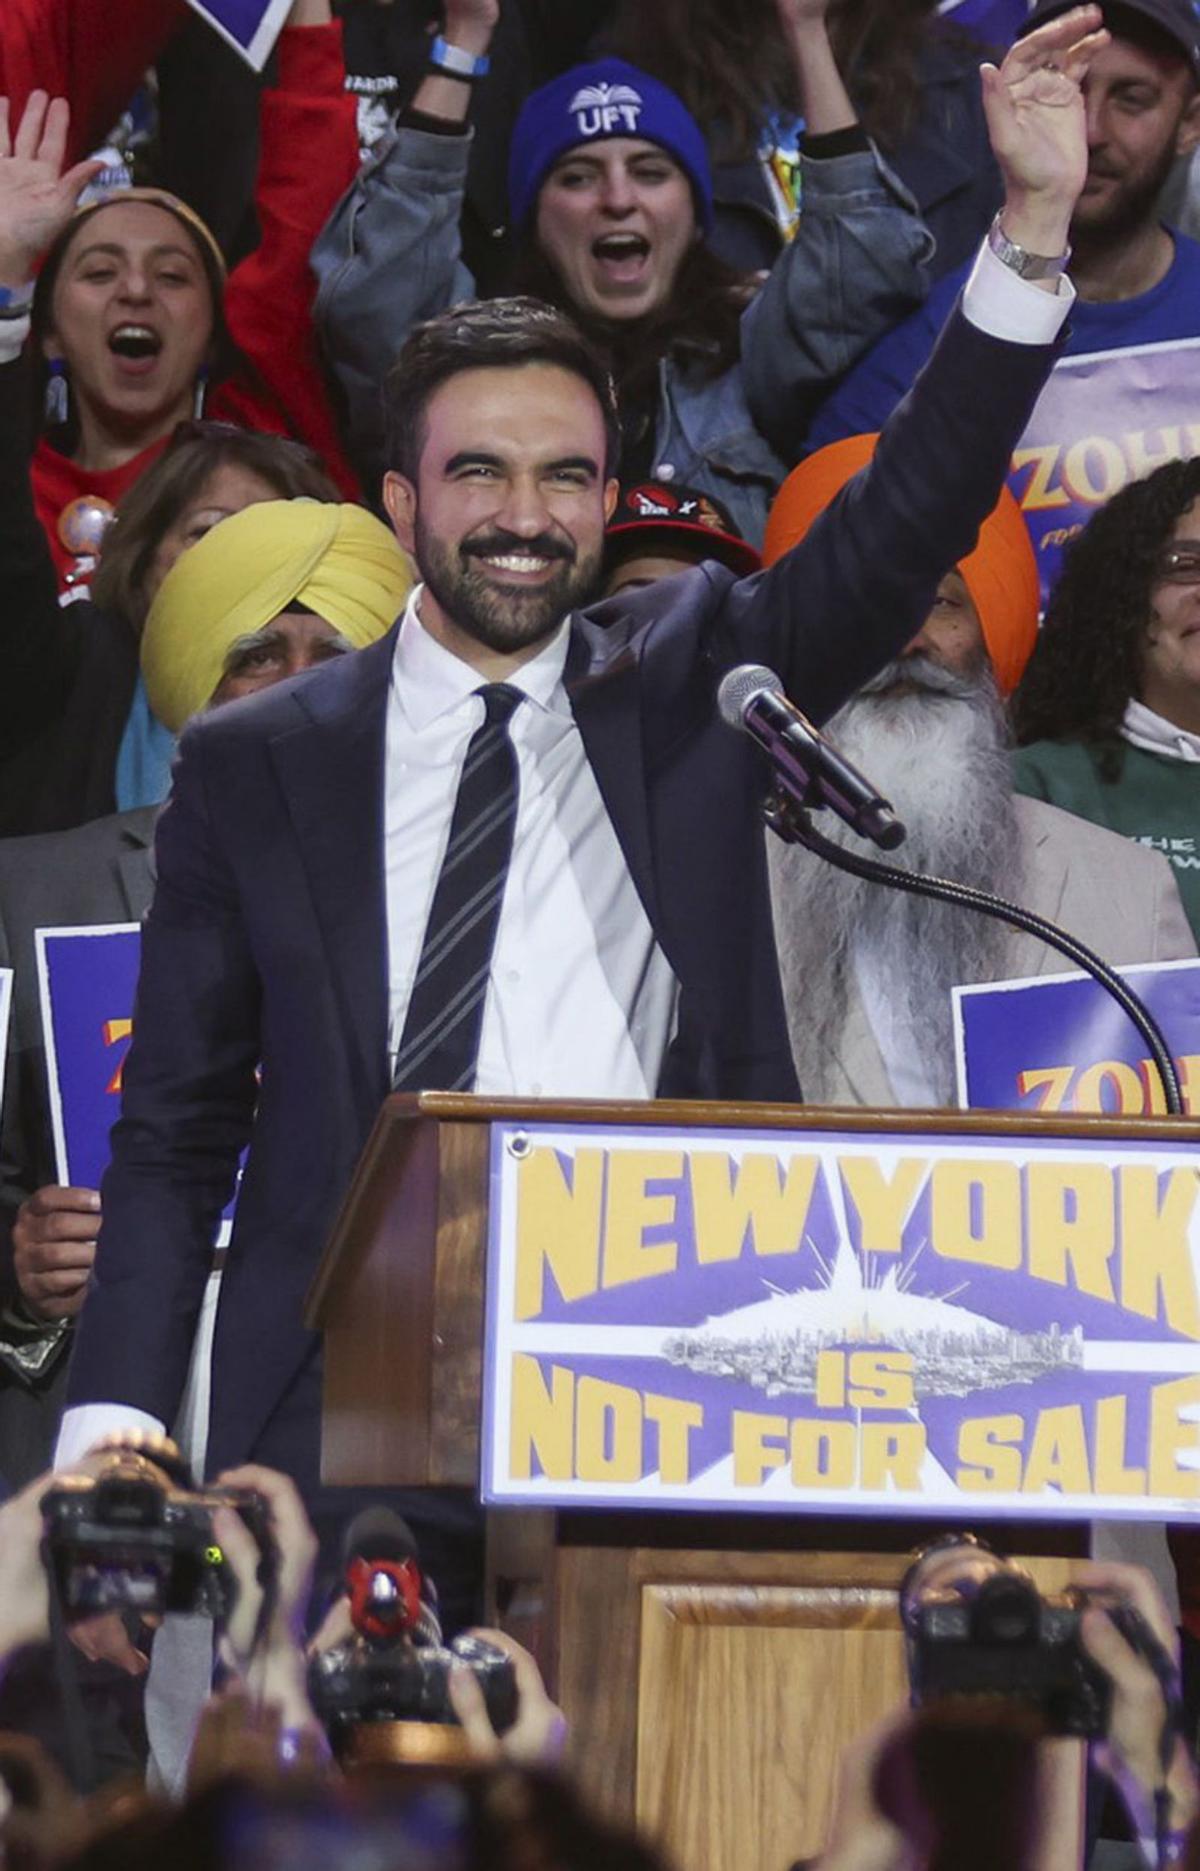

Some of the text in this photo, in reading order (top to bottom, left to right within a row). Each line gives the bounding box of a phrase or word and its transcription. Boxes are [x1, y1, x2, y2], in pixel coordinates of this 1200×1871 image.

[578, 105, 641, 135] UFT
[1010, 424, 1200, 512] ZOH
[1129, 835, 1196, 852] HE
[514, 1146, 1200, 1342] NEW YORK
[815, 1350, 915, 1408] IS
[509, 1351, 1200, 1497] NOT FOR SALE
